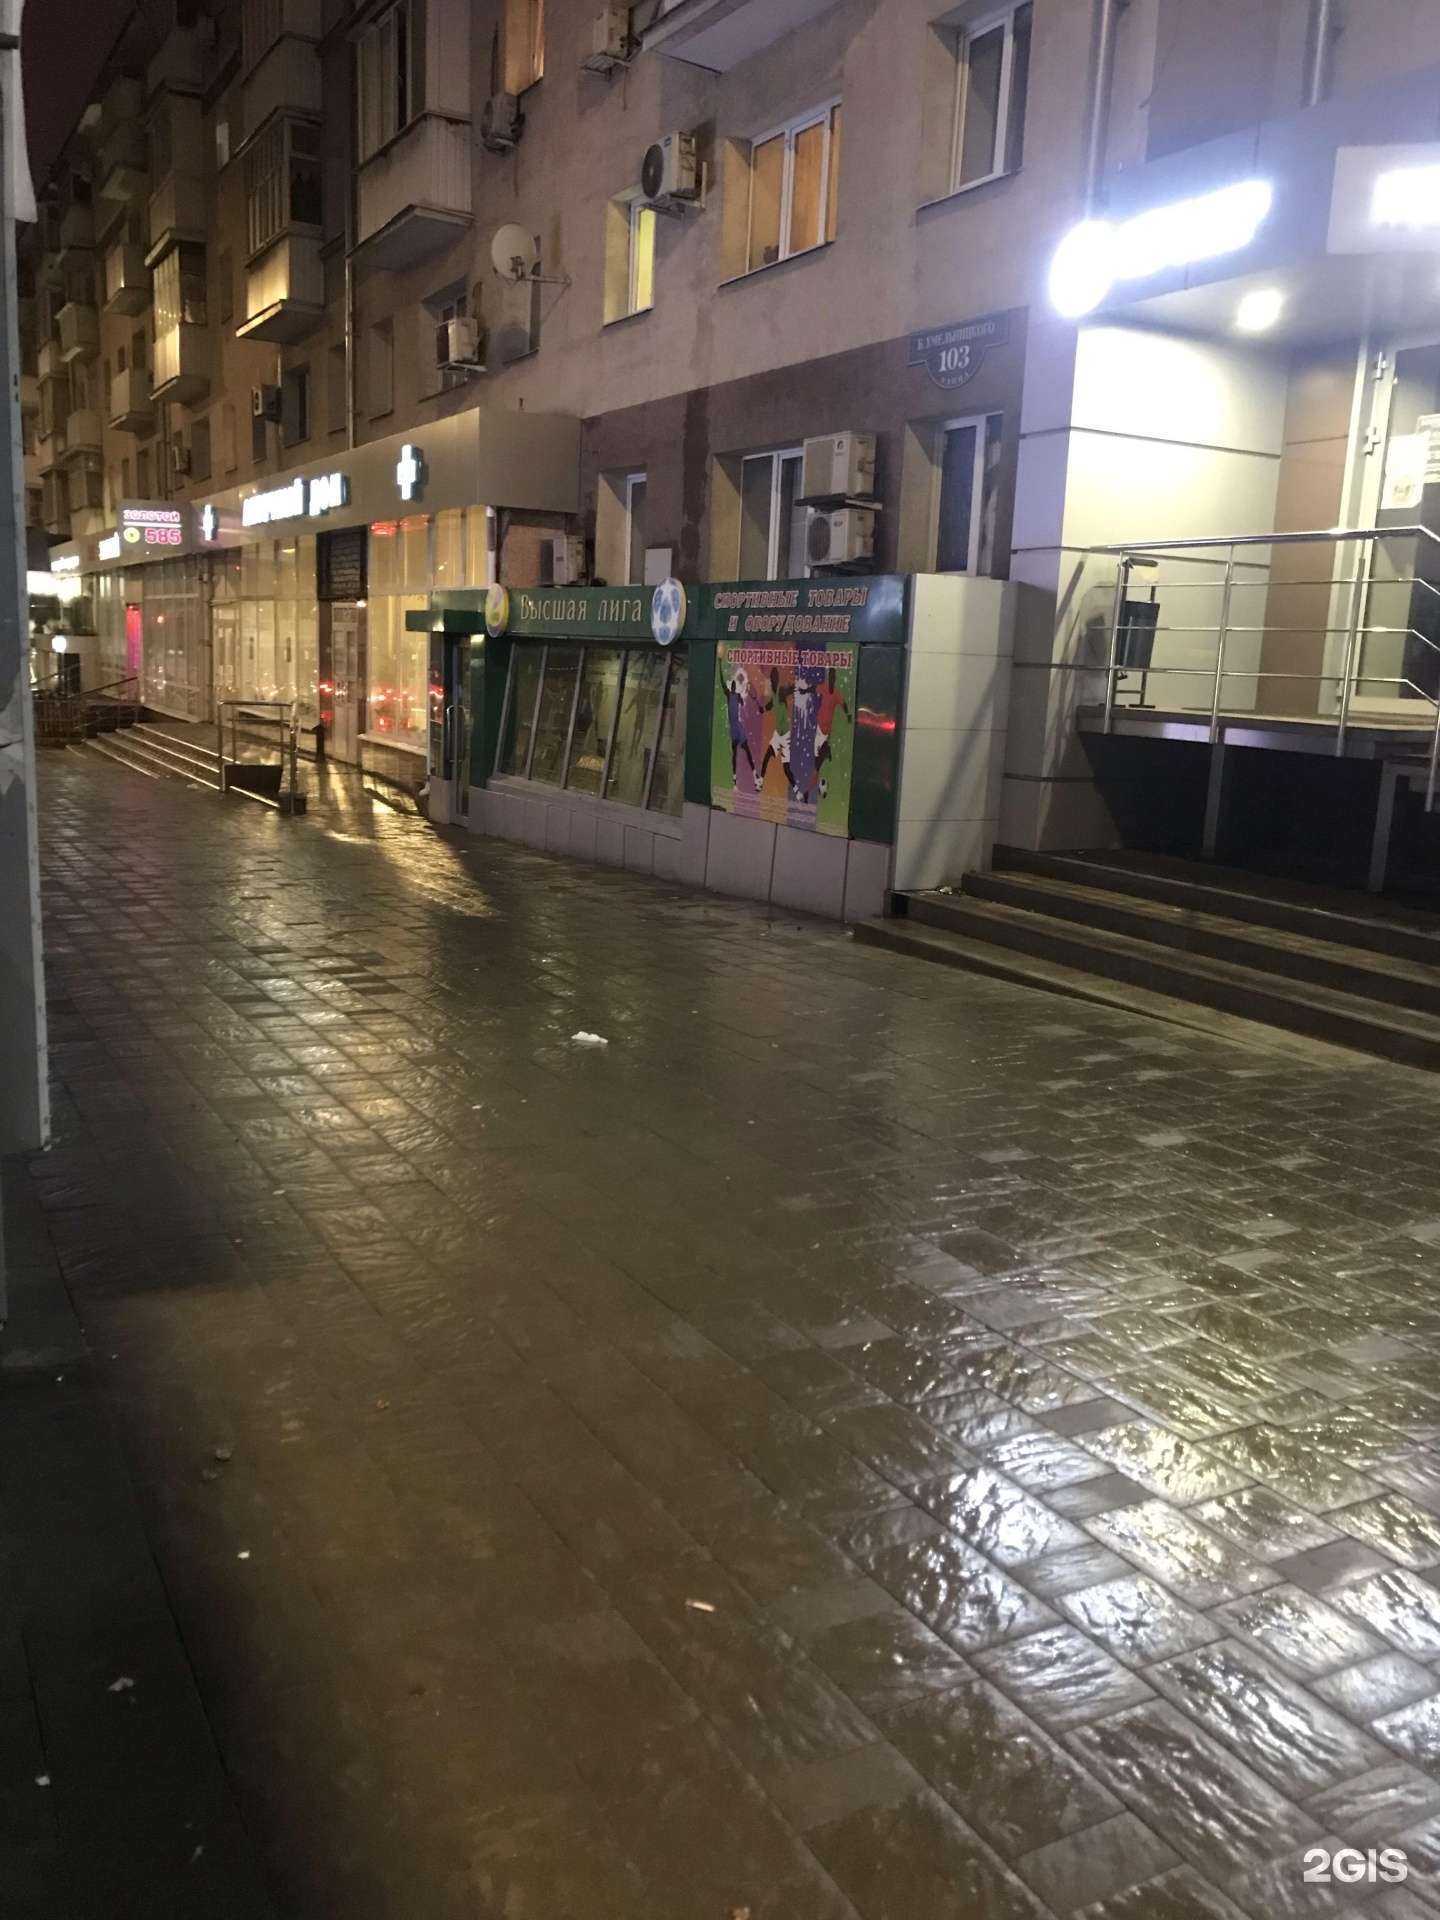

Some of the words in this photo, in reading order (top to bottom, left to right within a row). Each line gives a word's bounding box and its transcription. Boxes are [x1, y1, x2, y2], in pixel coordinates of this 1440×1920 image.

[938, 345, 970, 372] 103
[145, 527, 182, 545] 585
[520, 594, 587, 621] Высшая
[598, 599, 642, 622] лига
[714, 589, 799, 609] СПОРТИВНЫЕ
[808, 587, 868, 607] ТОВАРЫ
[728, 615, 738, 632] И
[745, 614, 851, 635] ОБОРУДОВАНИЕ
[727, 649, 800, 665] СПОРТИВНЫЕ
[800, 650, 853, 667] ТОВАРЫ
